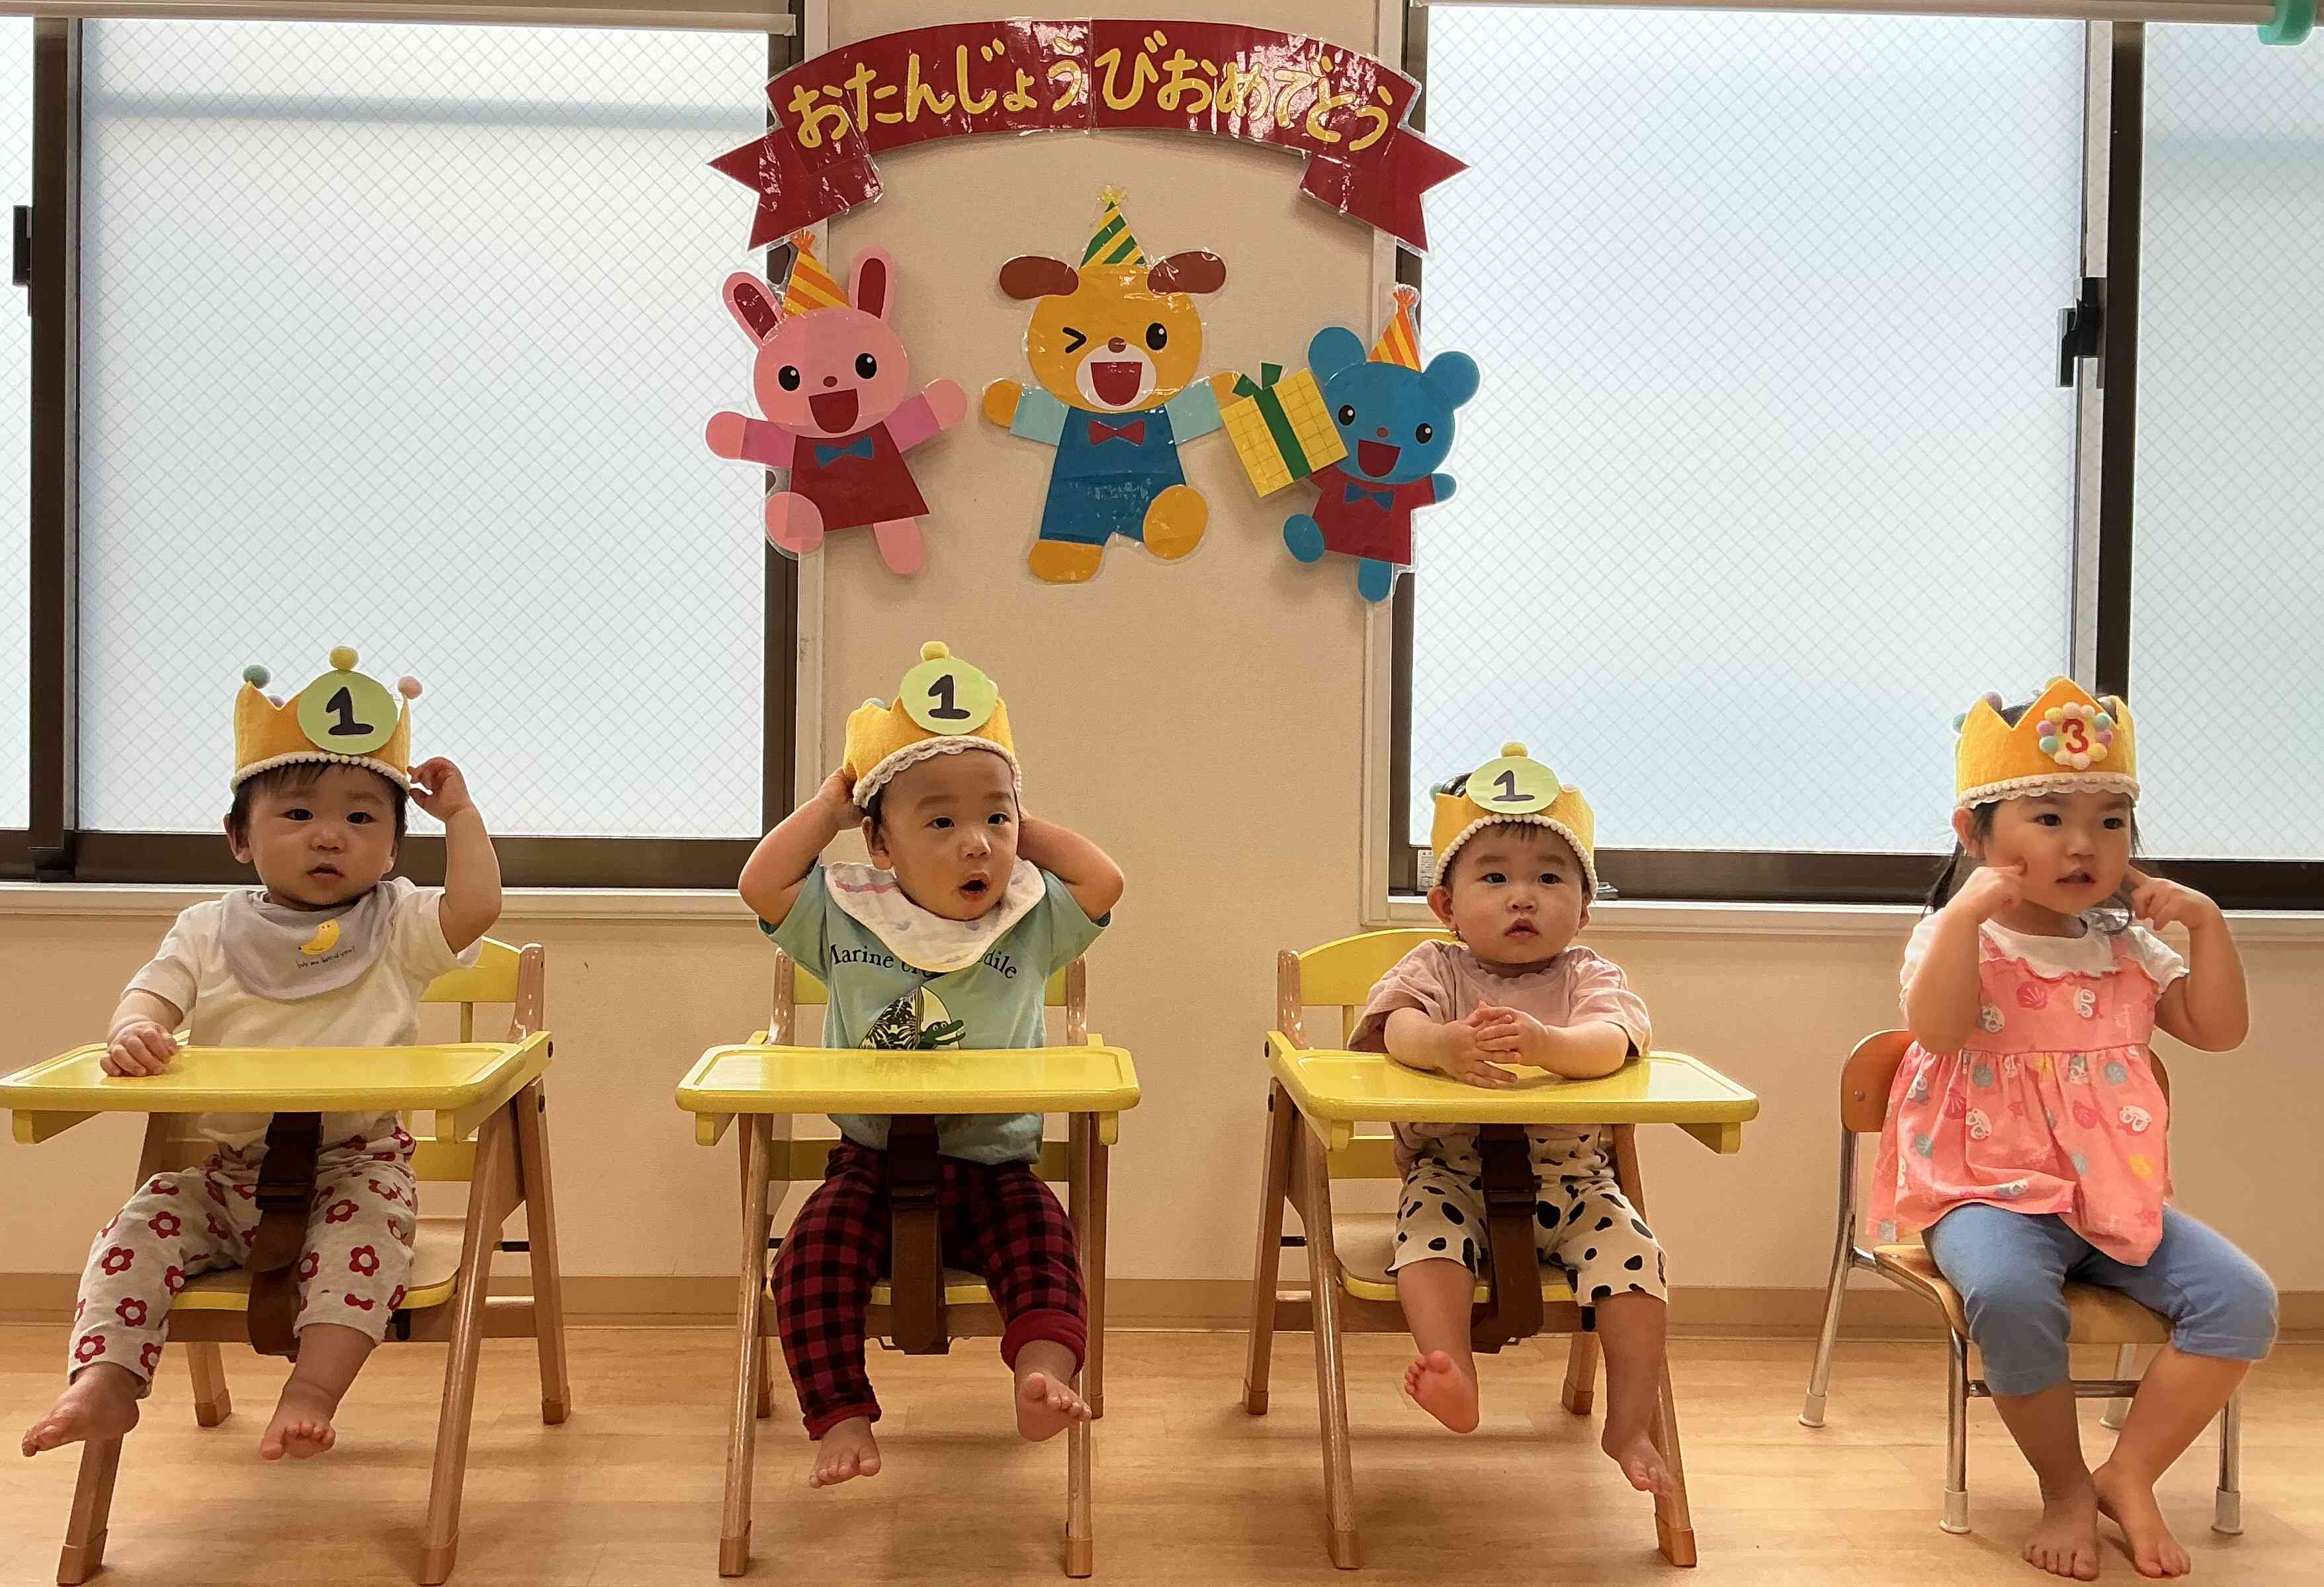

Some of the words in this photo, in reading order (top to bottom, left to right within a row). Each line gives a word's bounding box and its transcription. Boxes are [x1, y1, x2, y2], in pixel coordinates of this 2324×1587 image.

[788, 30, 1393, 151] おたんじょうびおめでとう
[325, 686, 374, 736] 1
[927, 674, 971, 720] 1
[2061, 718, 2089, 753] 3
[1491, 769, 1535, 802] 1
